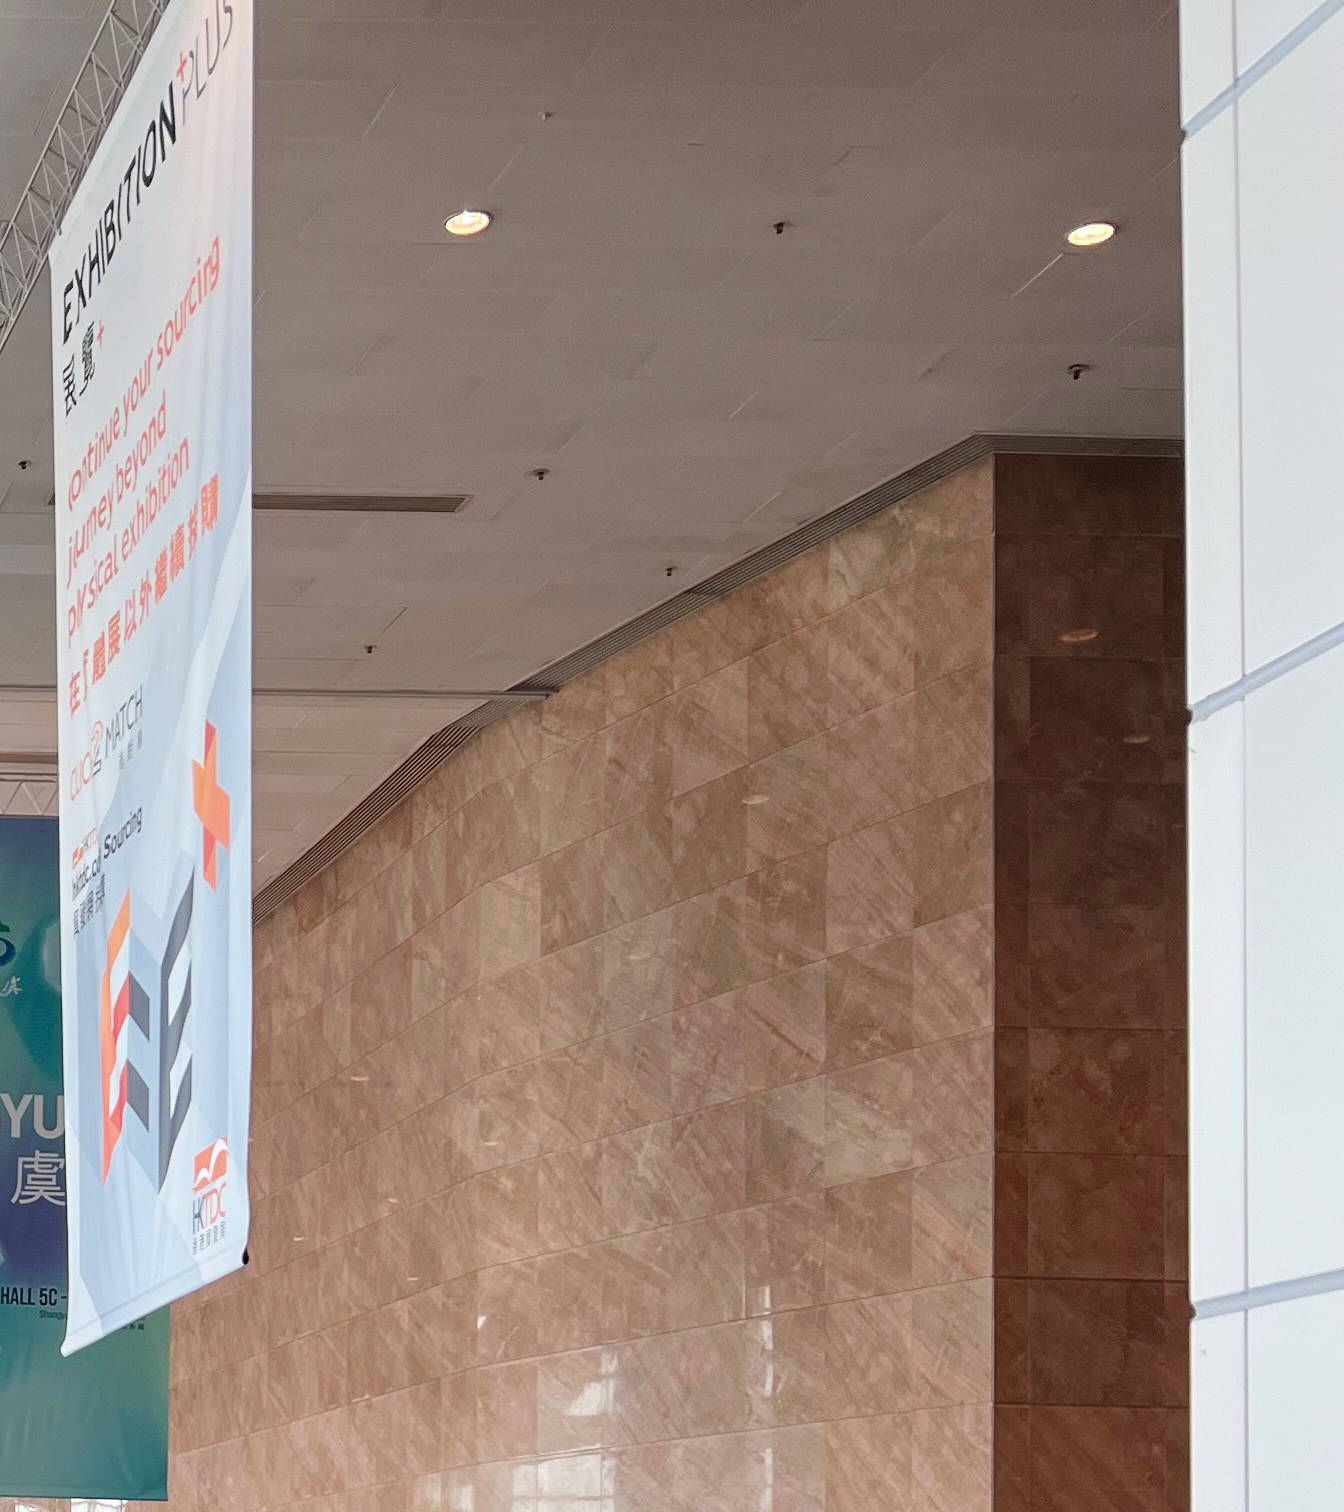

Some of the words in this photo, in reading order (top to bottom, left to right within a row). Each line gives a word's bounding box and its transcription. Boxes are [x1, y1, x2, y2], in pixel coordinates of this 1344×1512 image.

[123, 346, 154, 434] your
[157, 235, 221, 371] sourcing
[116, 402, 167, 504] beyond
[121, 438, 190, 562] exhibition
[0, 1287, 35, 1305] HALL
[39, 1288, 58, 1305] 5C
